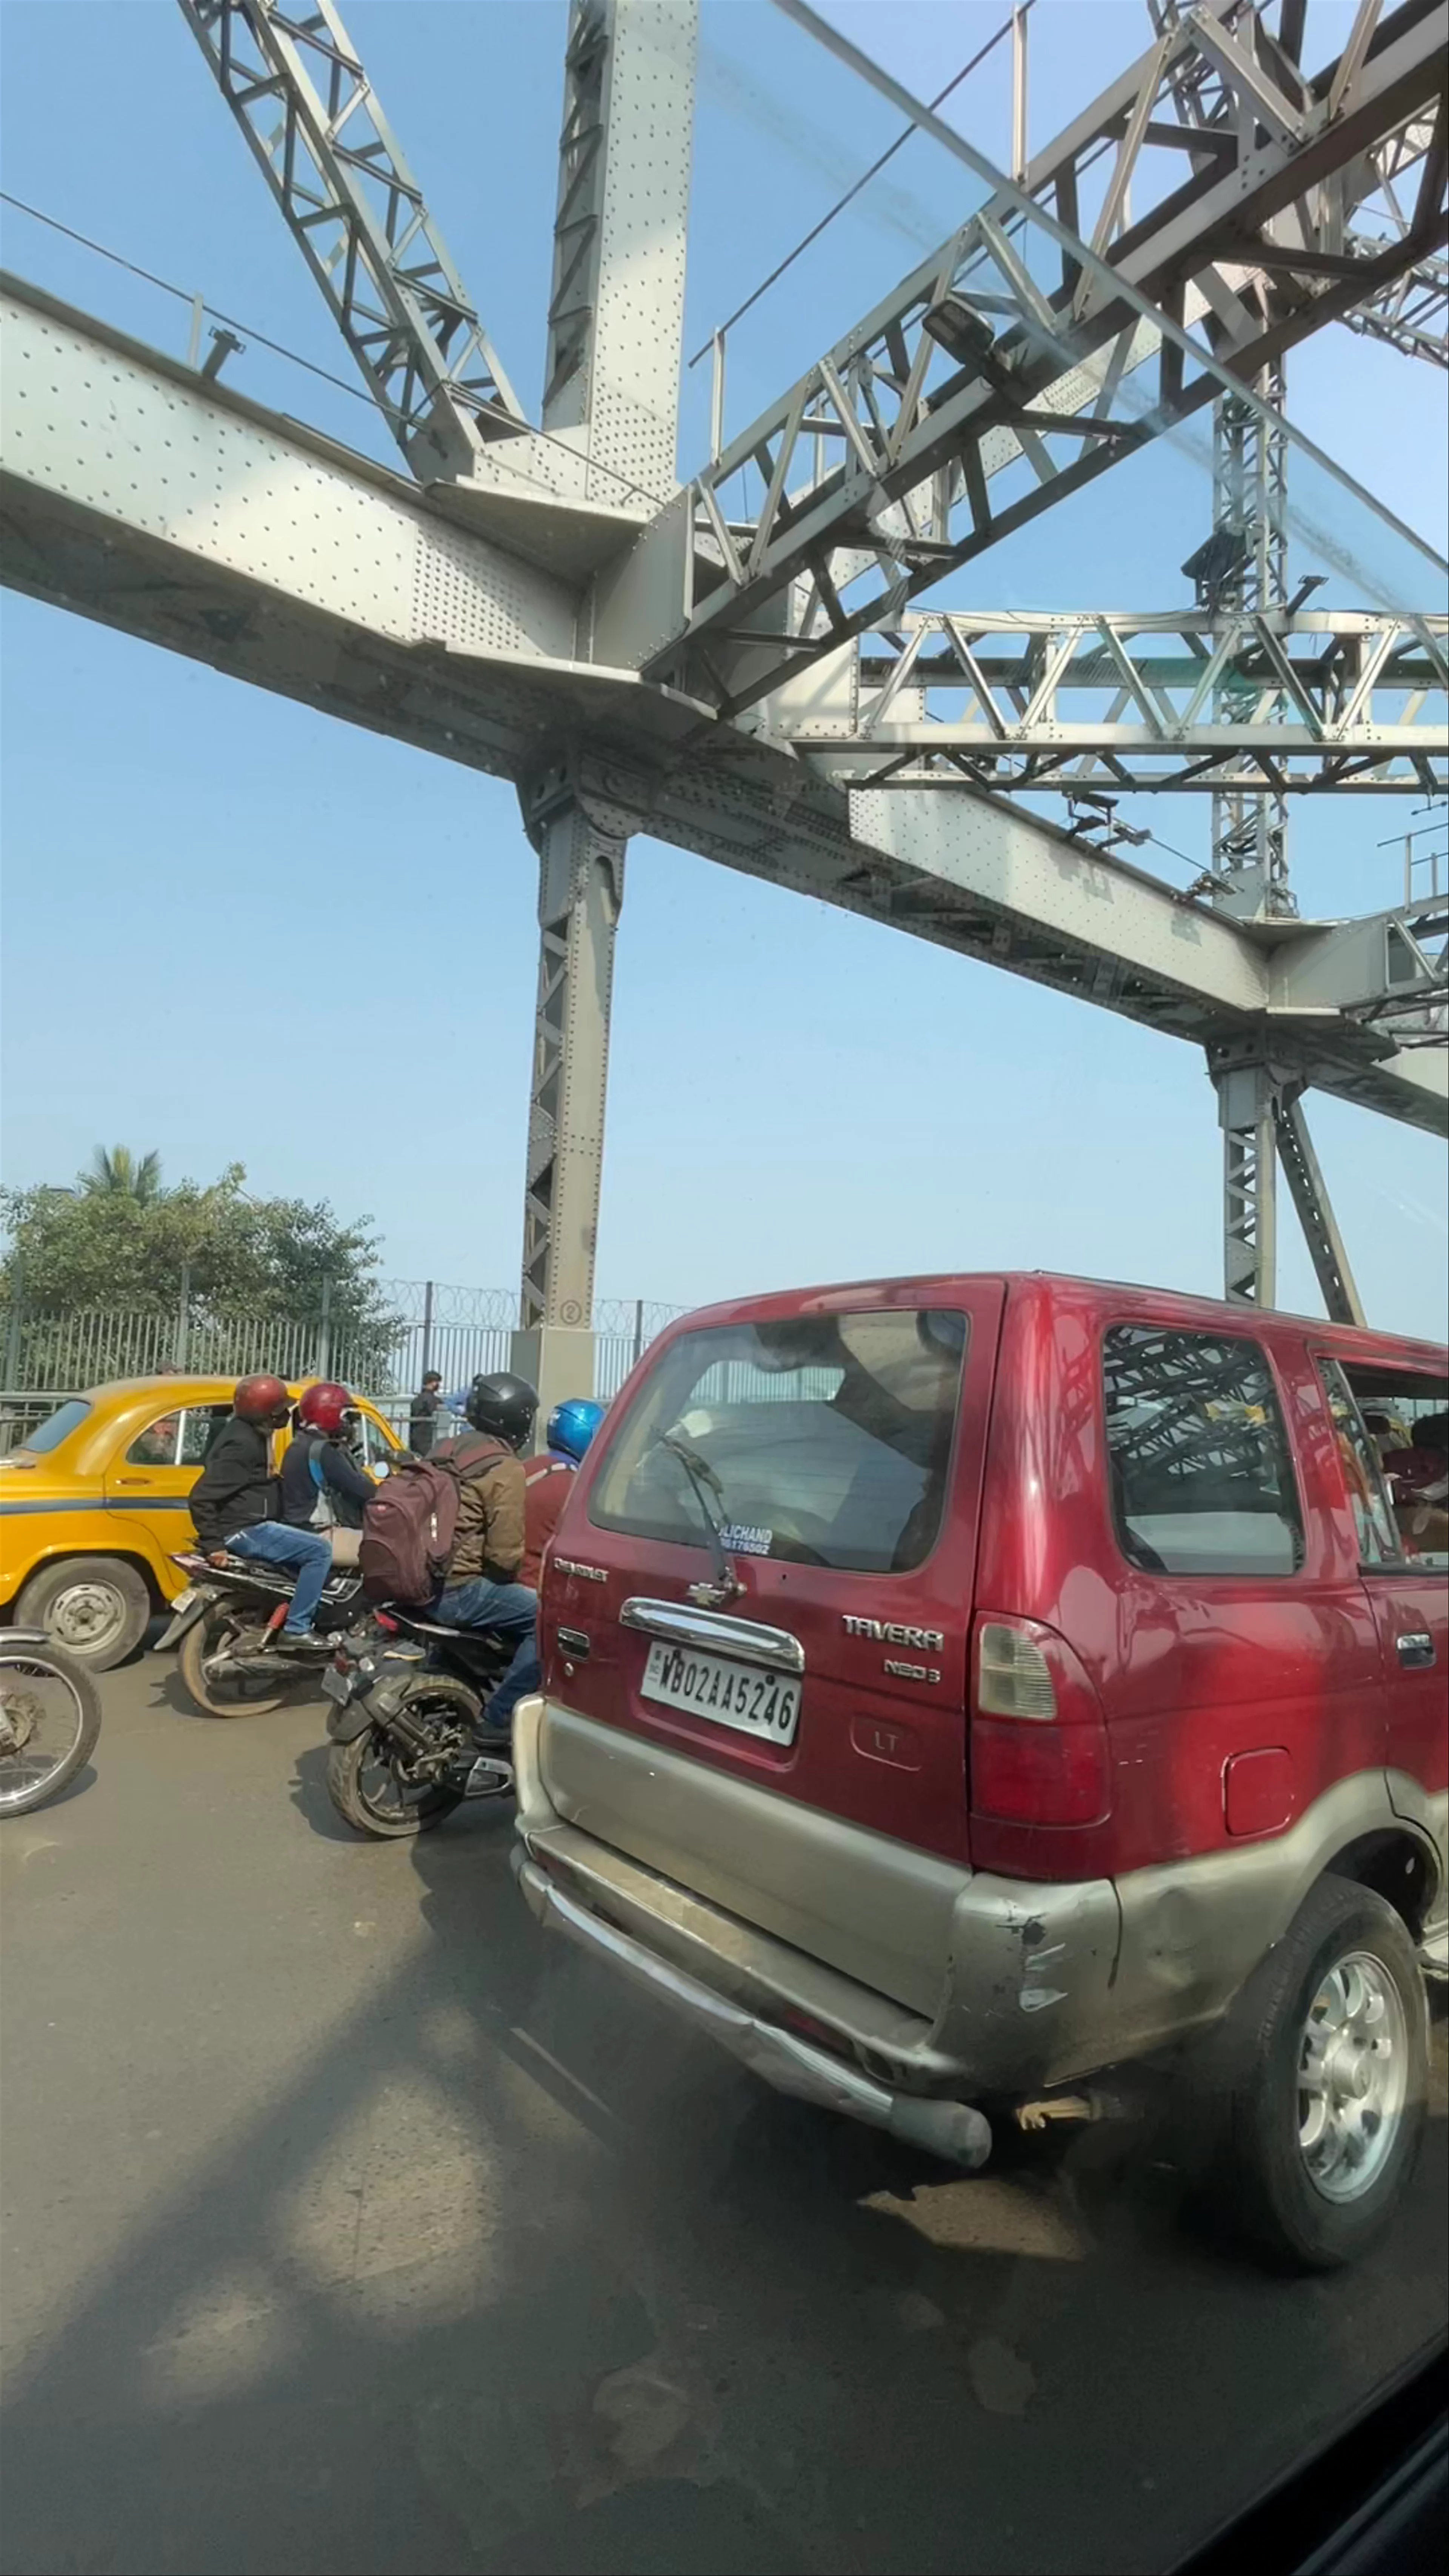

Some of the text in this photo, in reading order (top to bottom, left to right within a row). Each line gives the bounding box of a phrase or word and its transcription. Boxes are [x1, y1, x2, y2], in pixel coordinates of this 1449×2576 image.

[842, 1615, 944, 1652] TAVERA
[660, 1654, 794, 1730] WB02AA5246
[874, 1730, 899, 1753] LT
